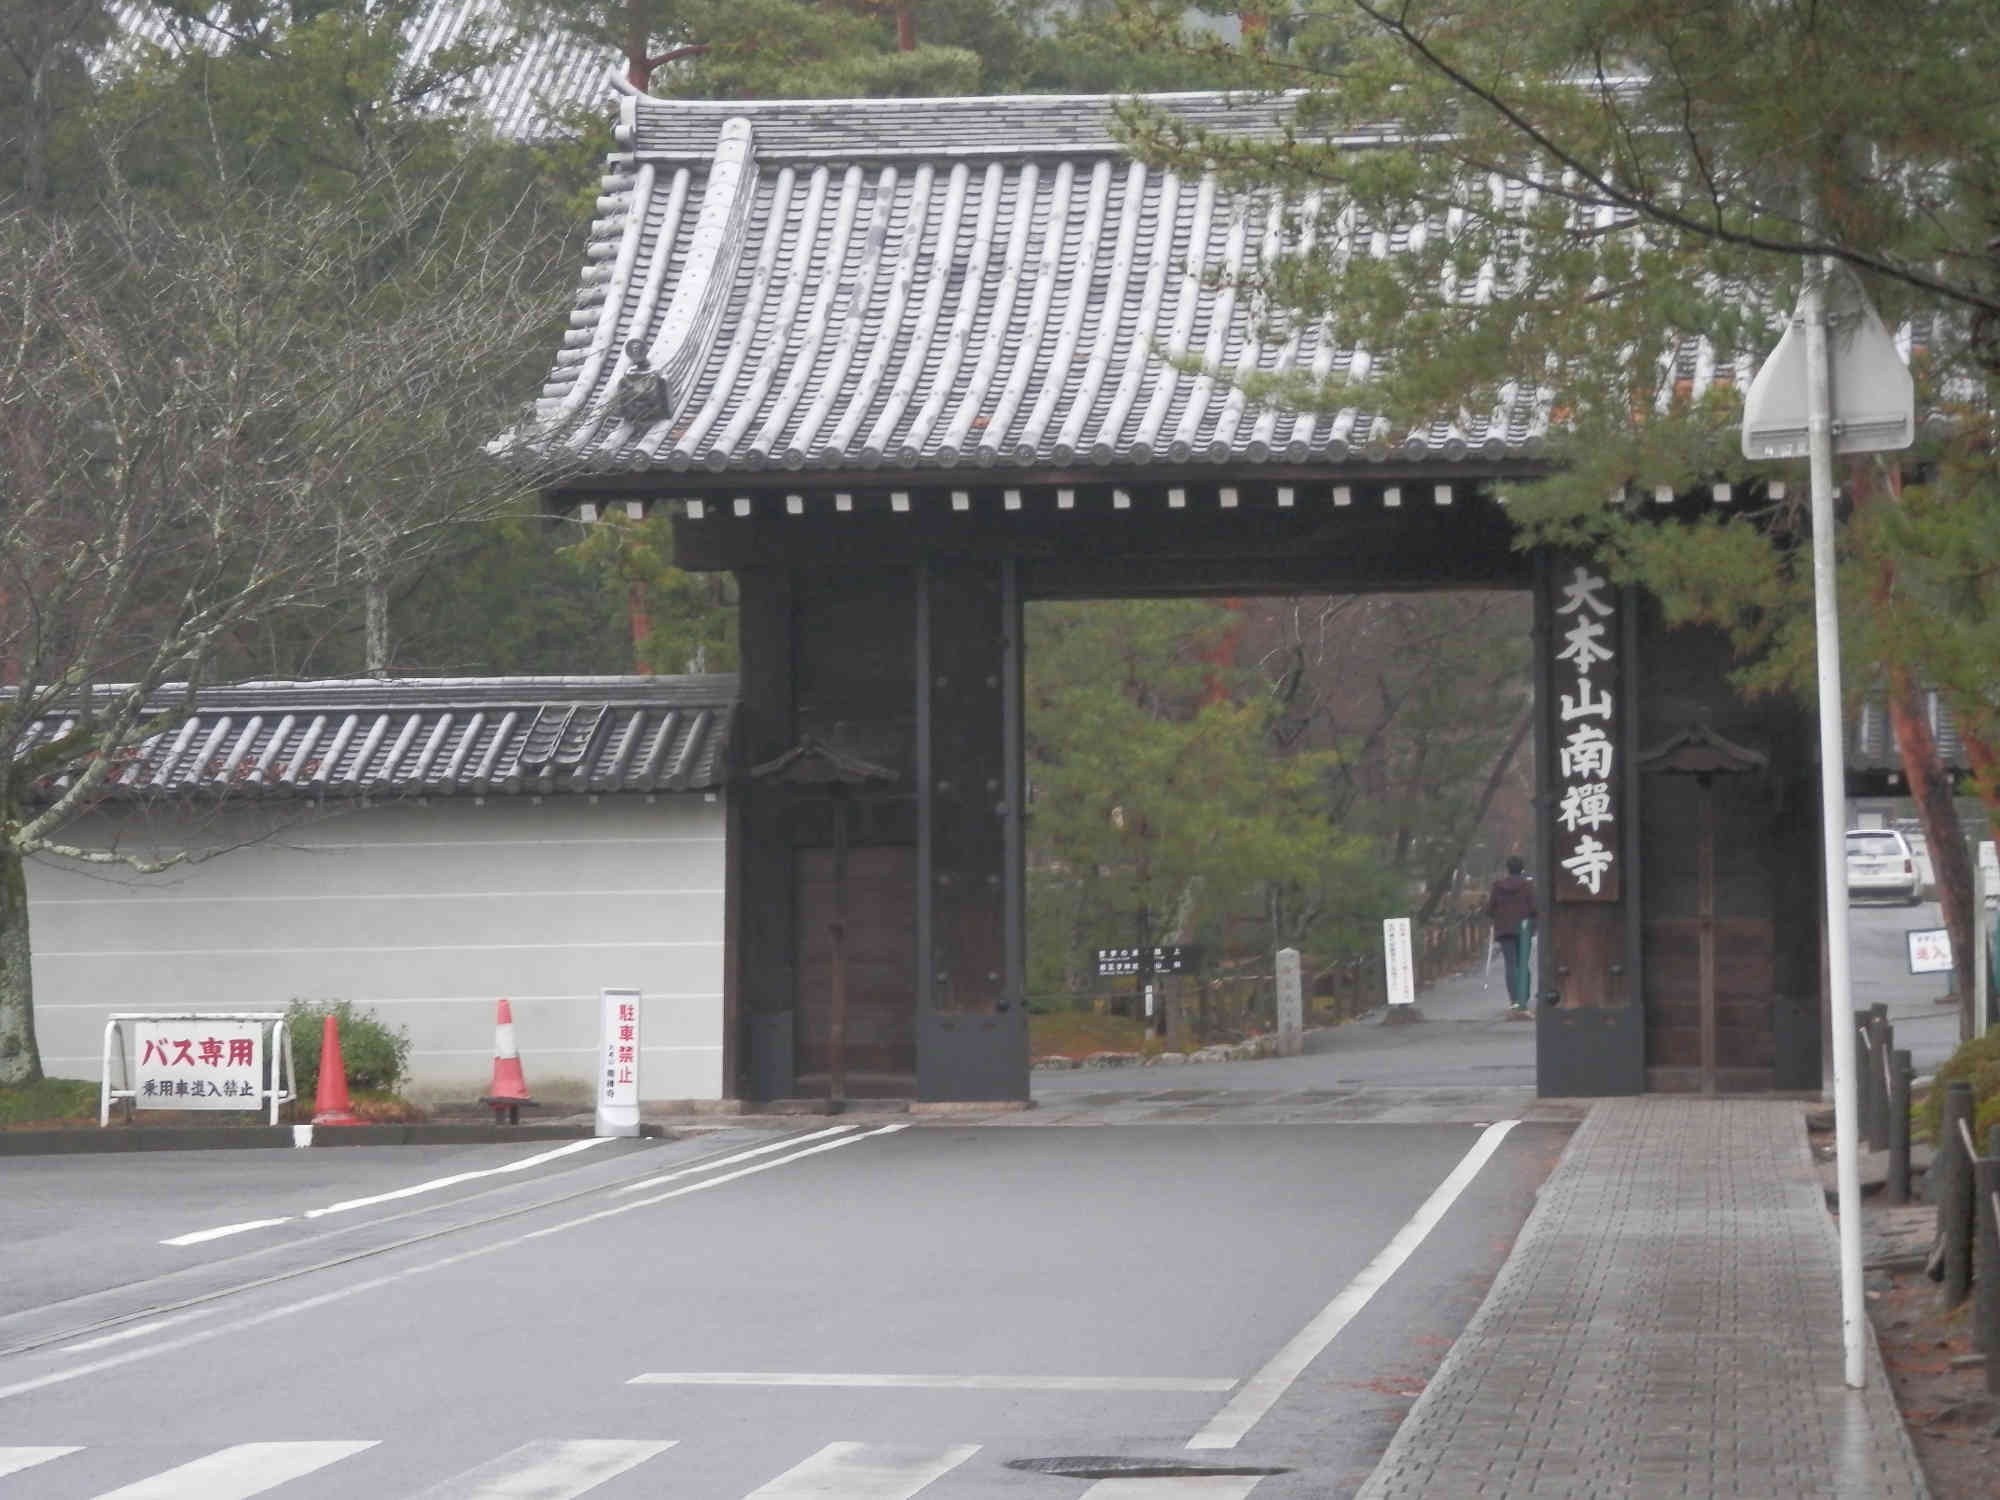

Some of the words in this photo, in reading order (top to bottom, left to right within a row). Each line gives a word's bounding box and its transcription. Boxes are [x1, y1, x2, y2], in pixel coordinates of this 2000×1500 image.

[1555, 566, 1614, 894] 大本山南禪寺
[142, 1037, 254, 1067] バス専用
[618, 1004, 635, 1084] 駐車禁止
[143, 1079, 255, 1097] 乗用車進入禁止
